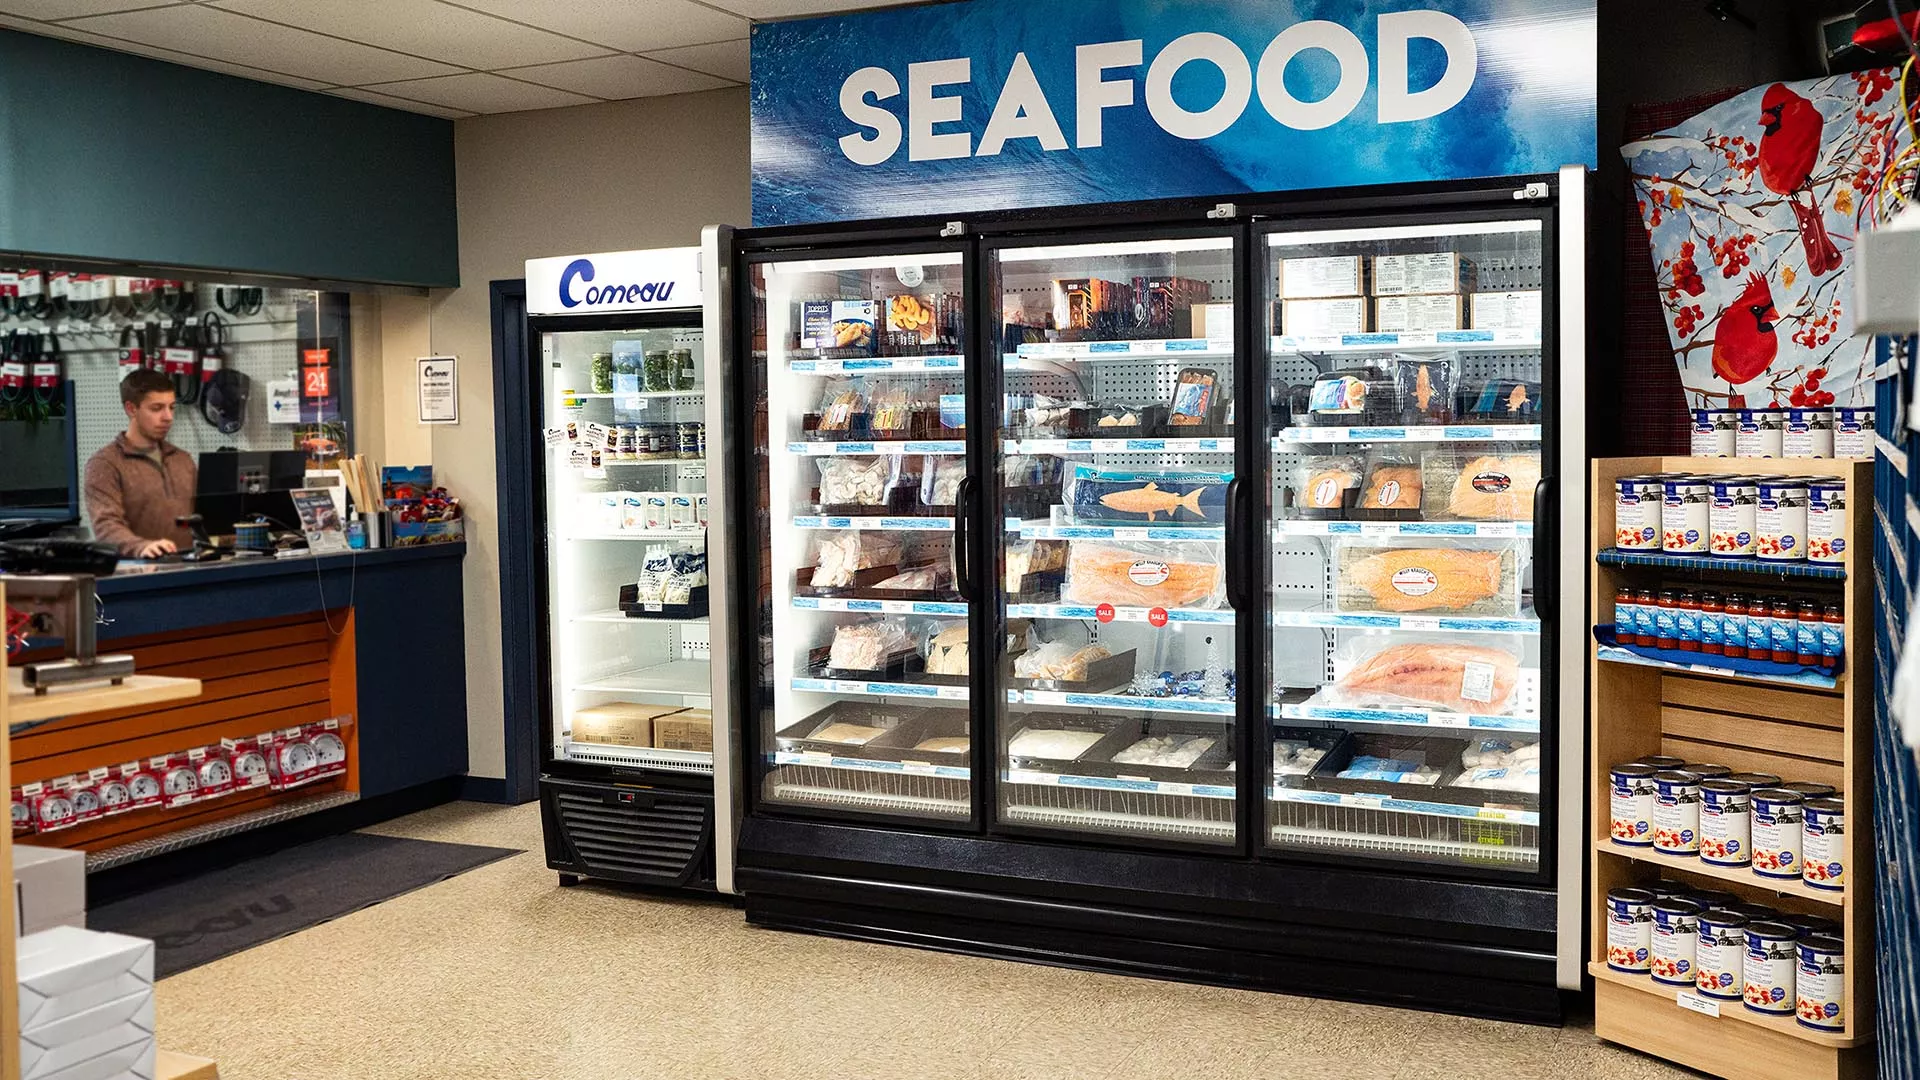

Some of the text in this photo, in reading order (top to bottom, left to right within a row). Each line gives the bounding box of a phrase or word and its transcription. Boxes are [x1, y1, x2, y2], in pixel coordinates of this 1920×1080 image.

[838, 9, 1480, 166] SEAFOOD
[559, 258, 676, 308] Comeau
[307, 372, 328, 392] 24
